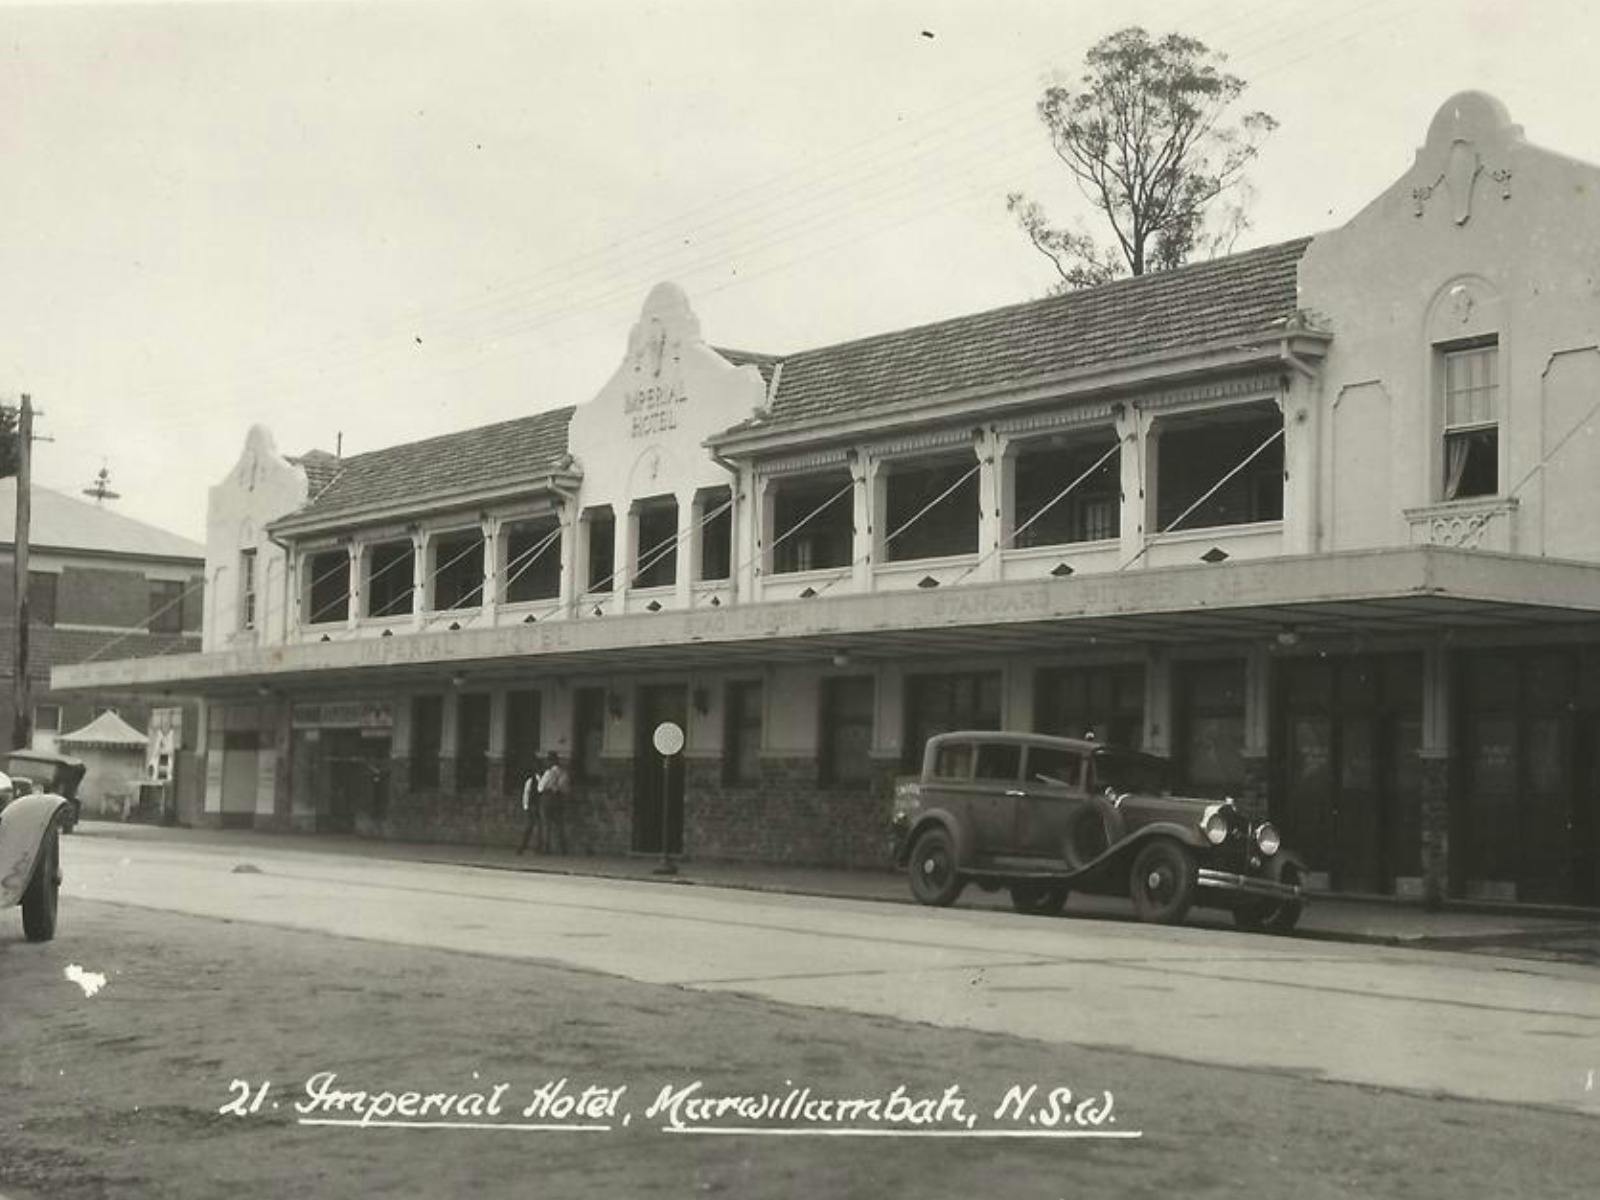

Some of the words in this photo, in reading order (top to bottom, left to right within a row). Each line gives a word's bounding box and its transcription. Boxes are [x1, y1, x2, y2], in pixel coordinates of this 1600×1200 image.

[624, 382, 688, 414] IMPERIAL
[631, 411, 677, 438] HOTEL
[361, 636, 455, 661] IMPERIAL
